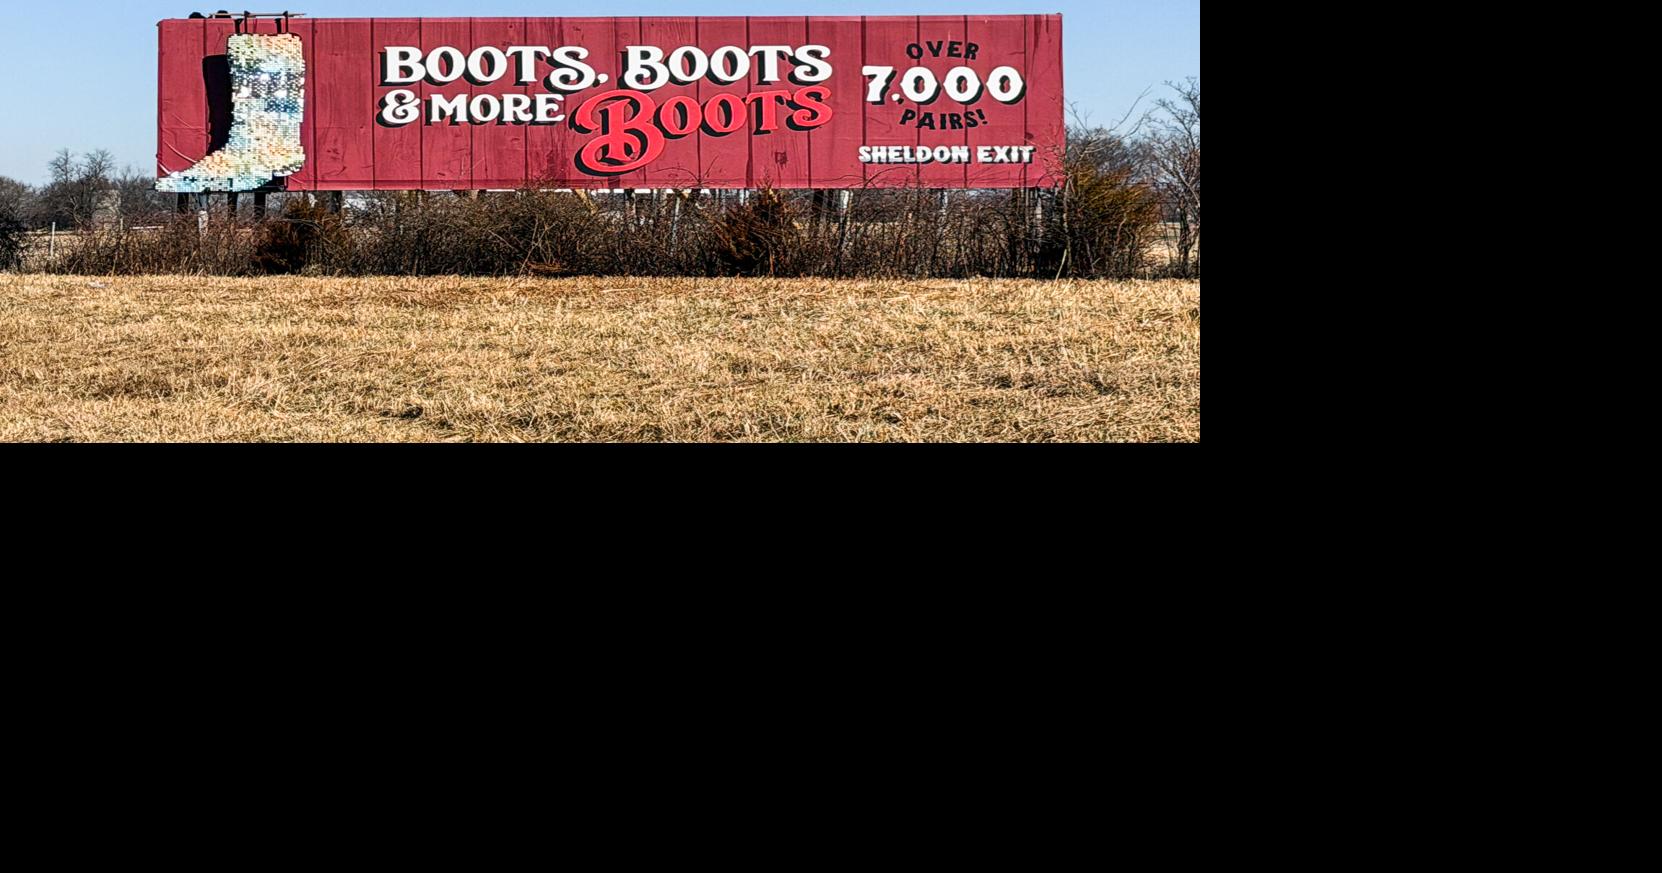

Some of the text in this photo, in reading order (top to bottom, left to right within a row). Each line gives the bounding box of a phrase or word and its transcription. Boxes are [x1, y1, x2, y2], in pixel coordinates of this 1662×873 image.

[906, 41, 979, 60] OVER
[624, 45, 833, 91] BOOTS
[381, 89, 420, 124] &
[430, 94, 565, 122] MORE
[900, 109, 988, 130] PAIRS!
[858, 146, 1034, 163] SHELDON EXIT
